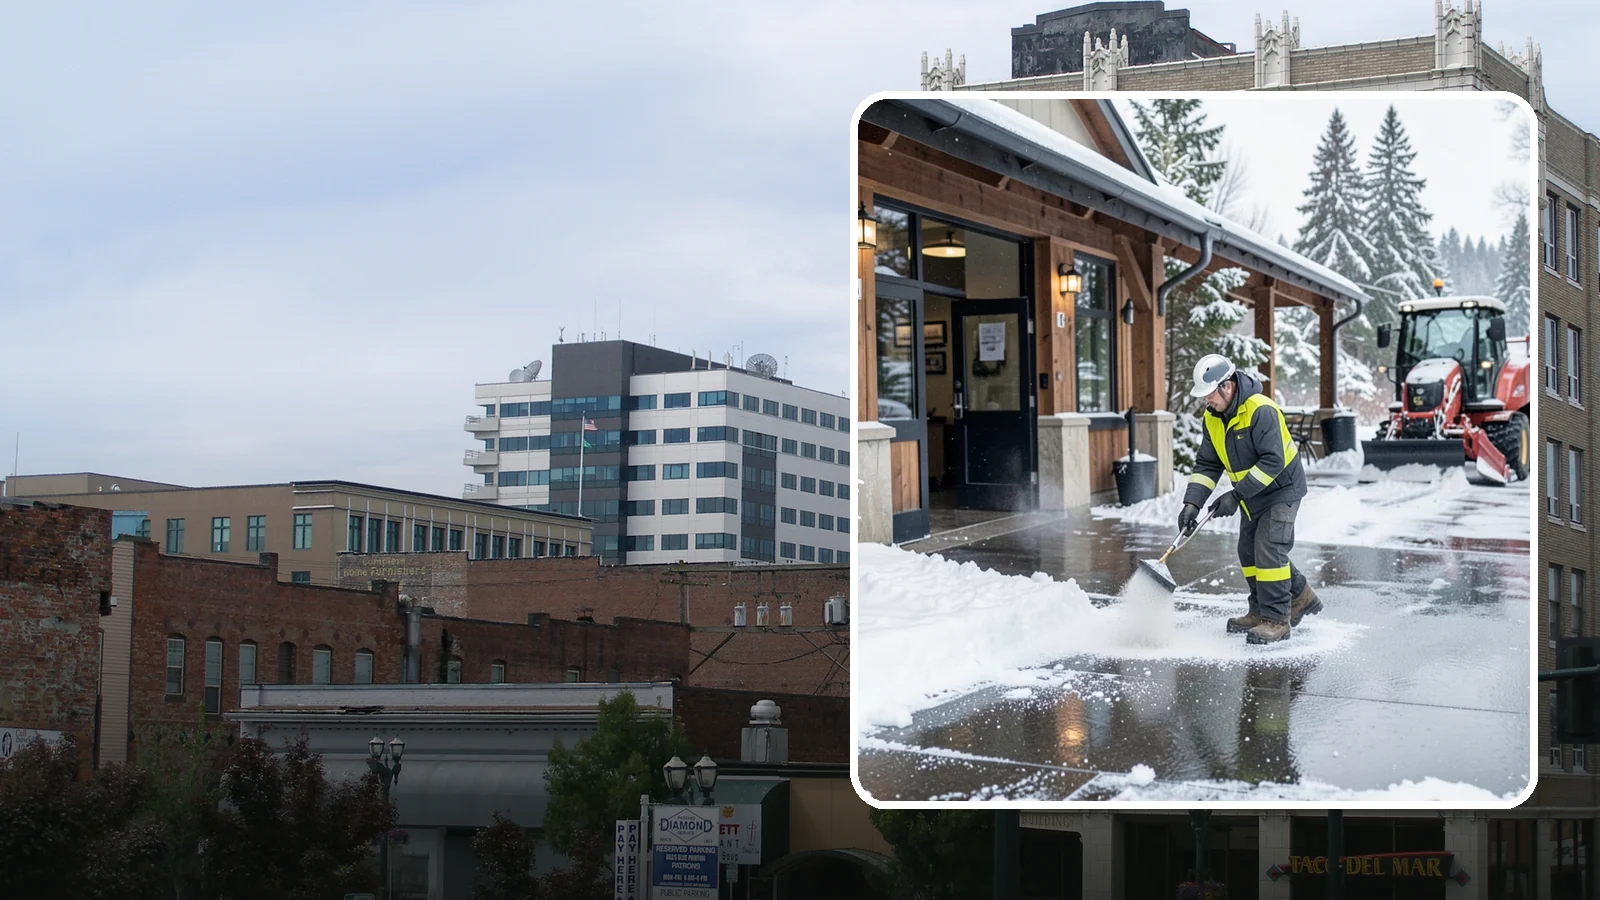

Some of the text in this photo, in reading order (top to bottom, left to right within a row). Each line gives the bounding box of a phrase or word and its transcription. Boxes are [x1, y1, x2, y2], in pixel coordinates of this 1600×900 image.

[370, 566, 427, 576] Furnishers
[660, 818, 713, 832] DIAMOND
[1022, 816, 1070, 827] BUILDING
[719, 824, 740, 835] ETT
[720, 840, 740, 848] ANT
[628, 825, 636, 893] PAY HERE
[722, 852, 739, 862] Soup
[1289, 856, 1442, 876] TAC DEL MAR
[616, 856, 624, 893] HERE
[660, 888, 710, 898] PUBLIC PARKING
